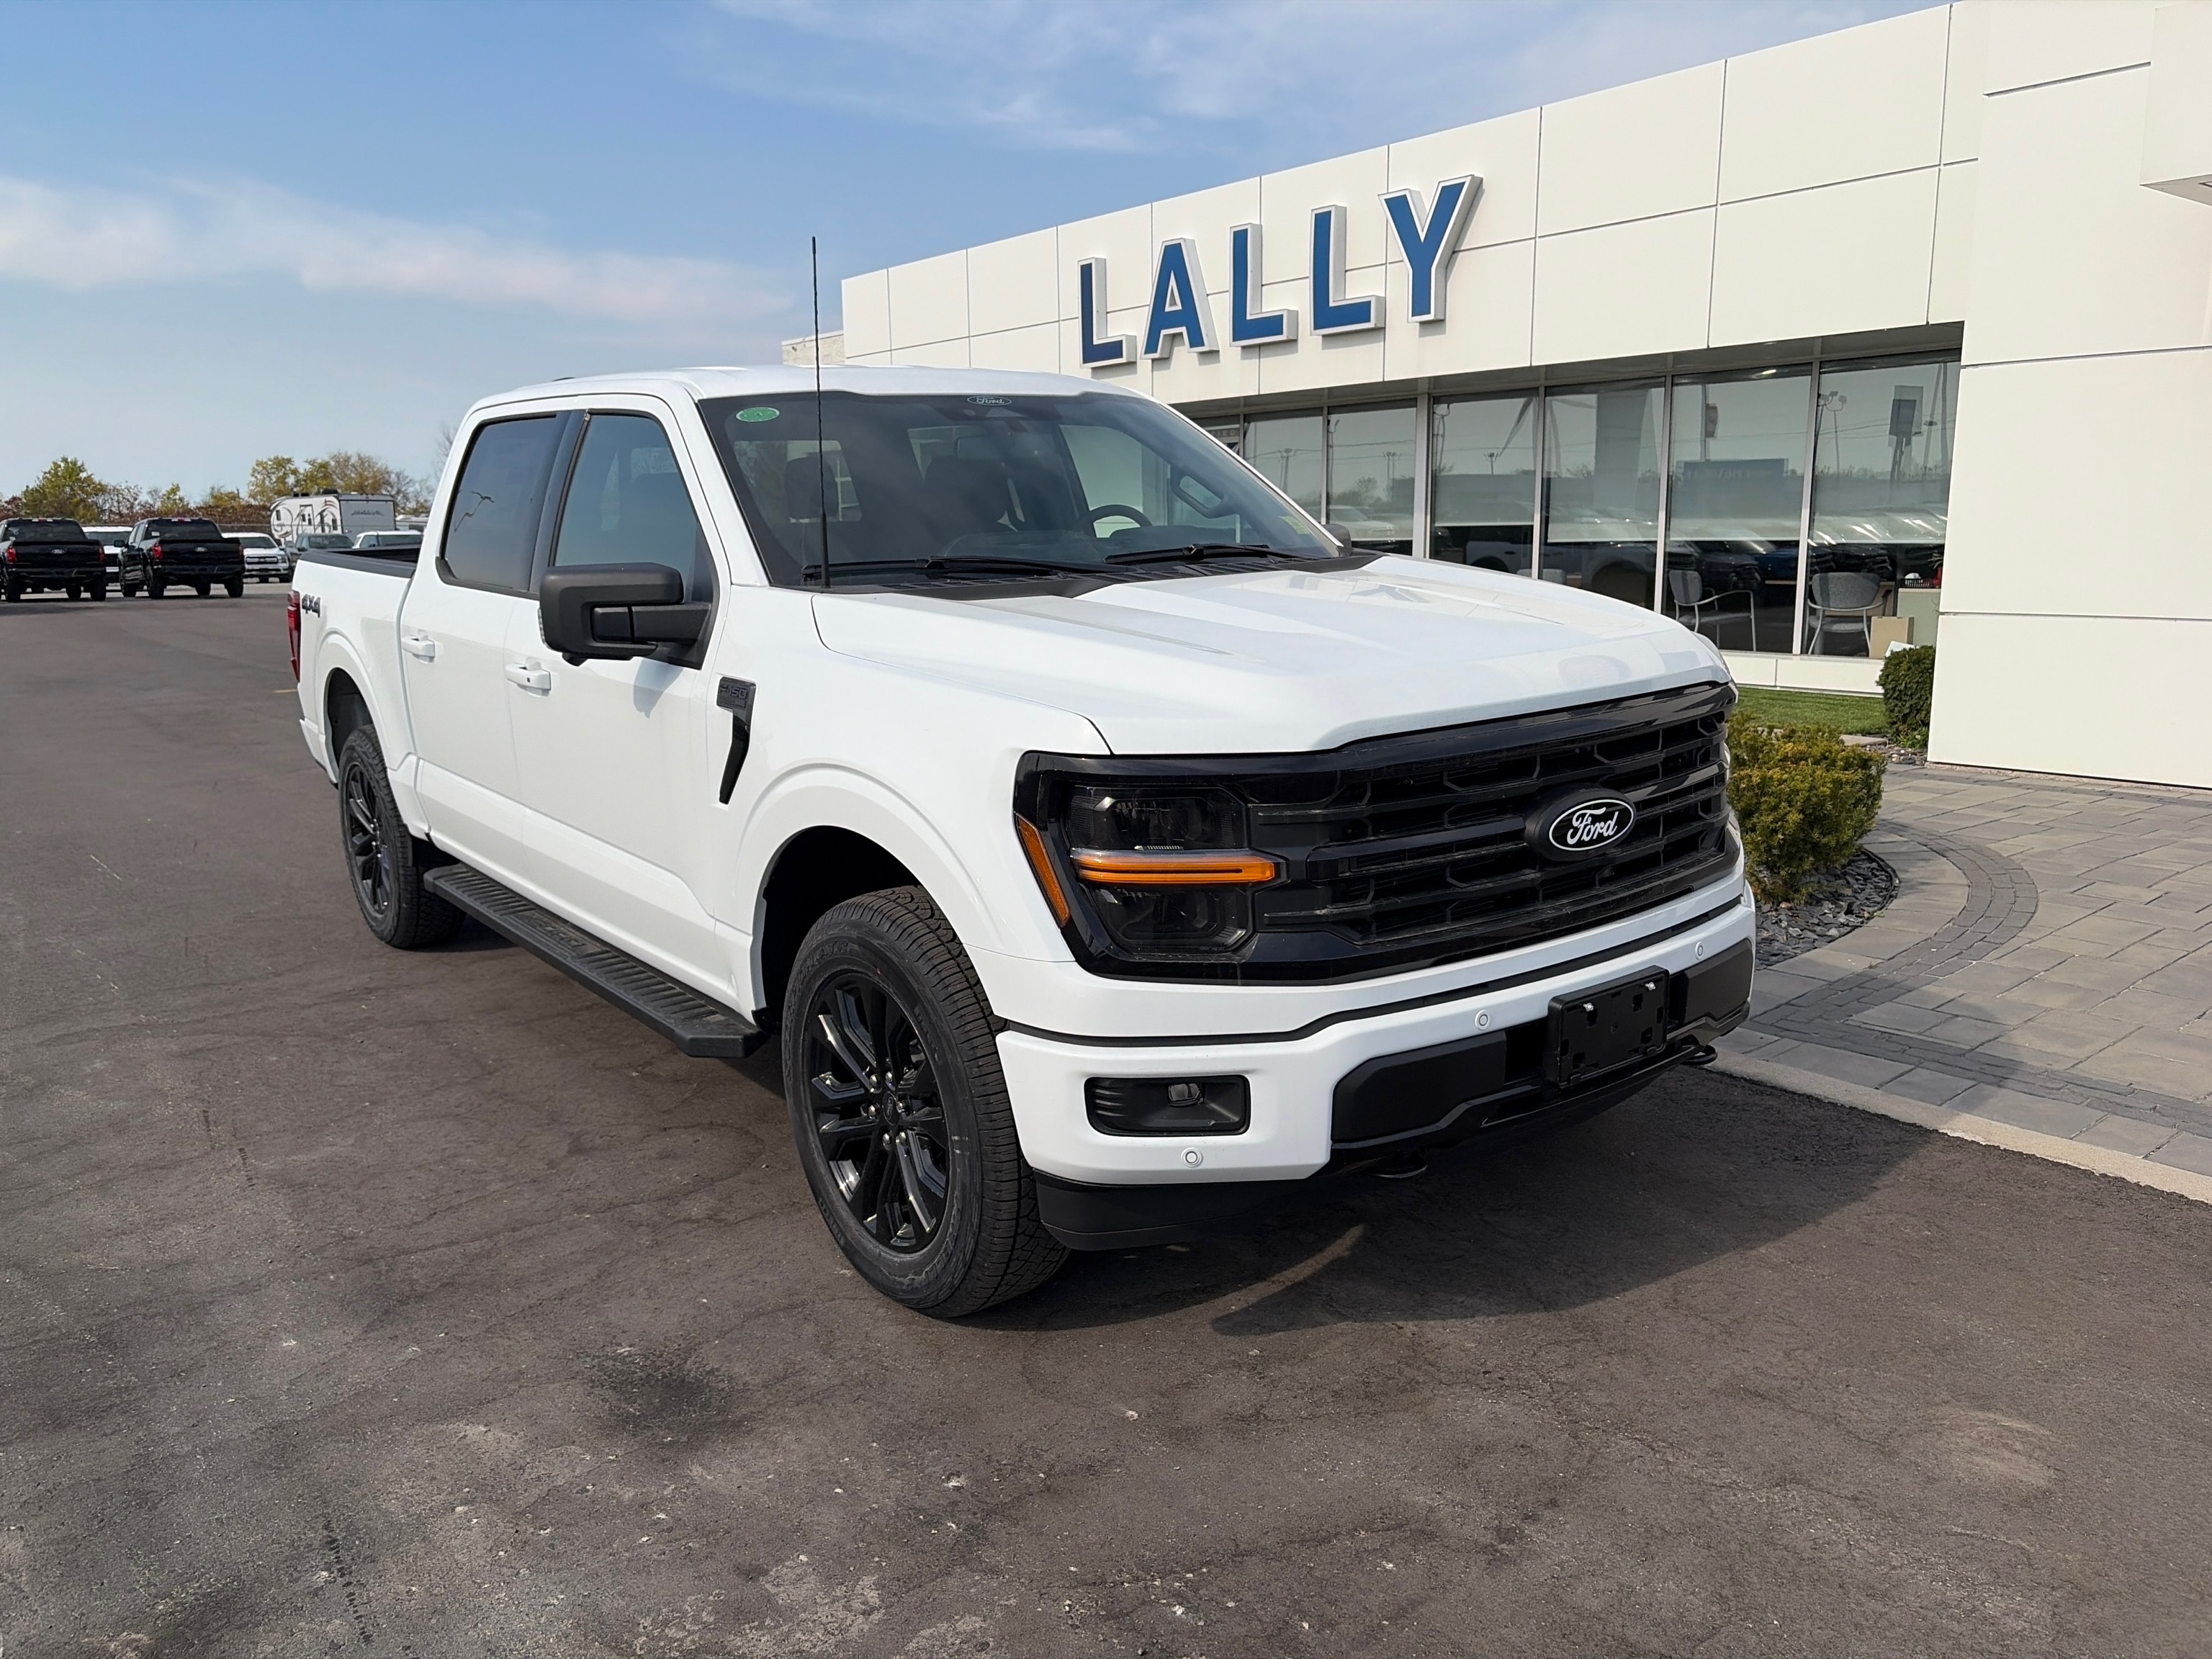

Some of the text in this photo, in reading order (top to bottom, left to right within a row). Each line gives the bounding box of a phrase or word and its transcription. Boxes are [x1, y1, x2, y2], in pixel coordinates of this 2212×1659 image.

[1078, 174, 1483, 368] LALLY
[976, 396, 1005, 405] Ford
[1567, 806, 1619, 845] Ford
